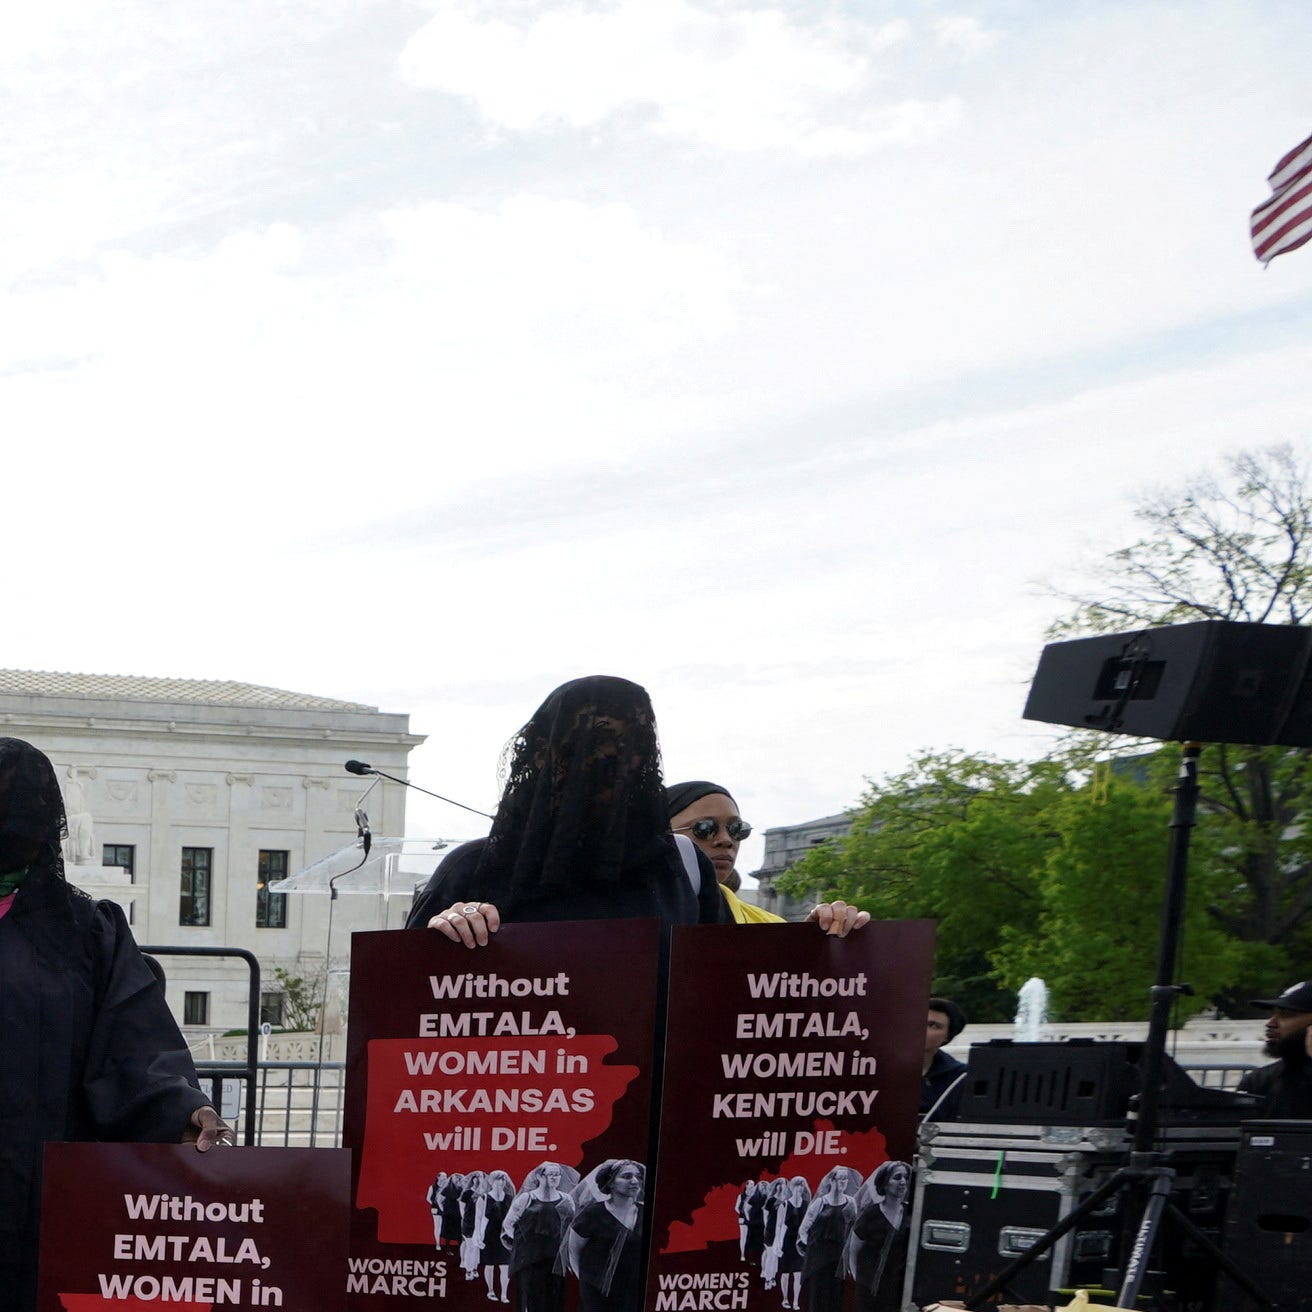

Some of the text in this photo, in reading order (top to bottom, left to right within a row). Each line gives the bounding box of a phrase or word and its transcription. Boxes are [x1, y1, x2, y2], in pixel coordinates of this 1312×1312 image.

[430, 973, 569, 999] Without
[747, 972, 867, 998] Without
[420, 1011, 575, 1039] EMTALA,
[737, 1012, 869, 1040] EMTALA,
[404, 1049, 587, 1075] WOMEN in
[721, 1050, 876, 1078] WOMEN in
[394, 1089, 594, 1112] ARKANSAS
[713, 1090, 878, 1118] KENTUCKY
[424, 1126, 557, 1151] will DIE.
[736, 1131, 847, 1156] will DIE.
[125, 1194, 264, 1222] Without
[114, 1235, 270, 1269] EMTALA,
[348, 1258, 446, 1276] WOMEN'S
[98, 1274, 282, 1306] WOMEN in
[347, 1274, 446, 1297] MARCH
[659, 1272, 749, 1290] WOMEN'S
[655, 1289, 748, 1311] MARCH
